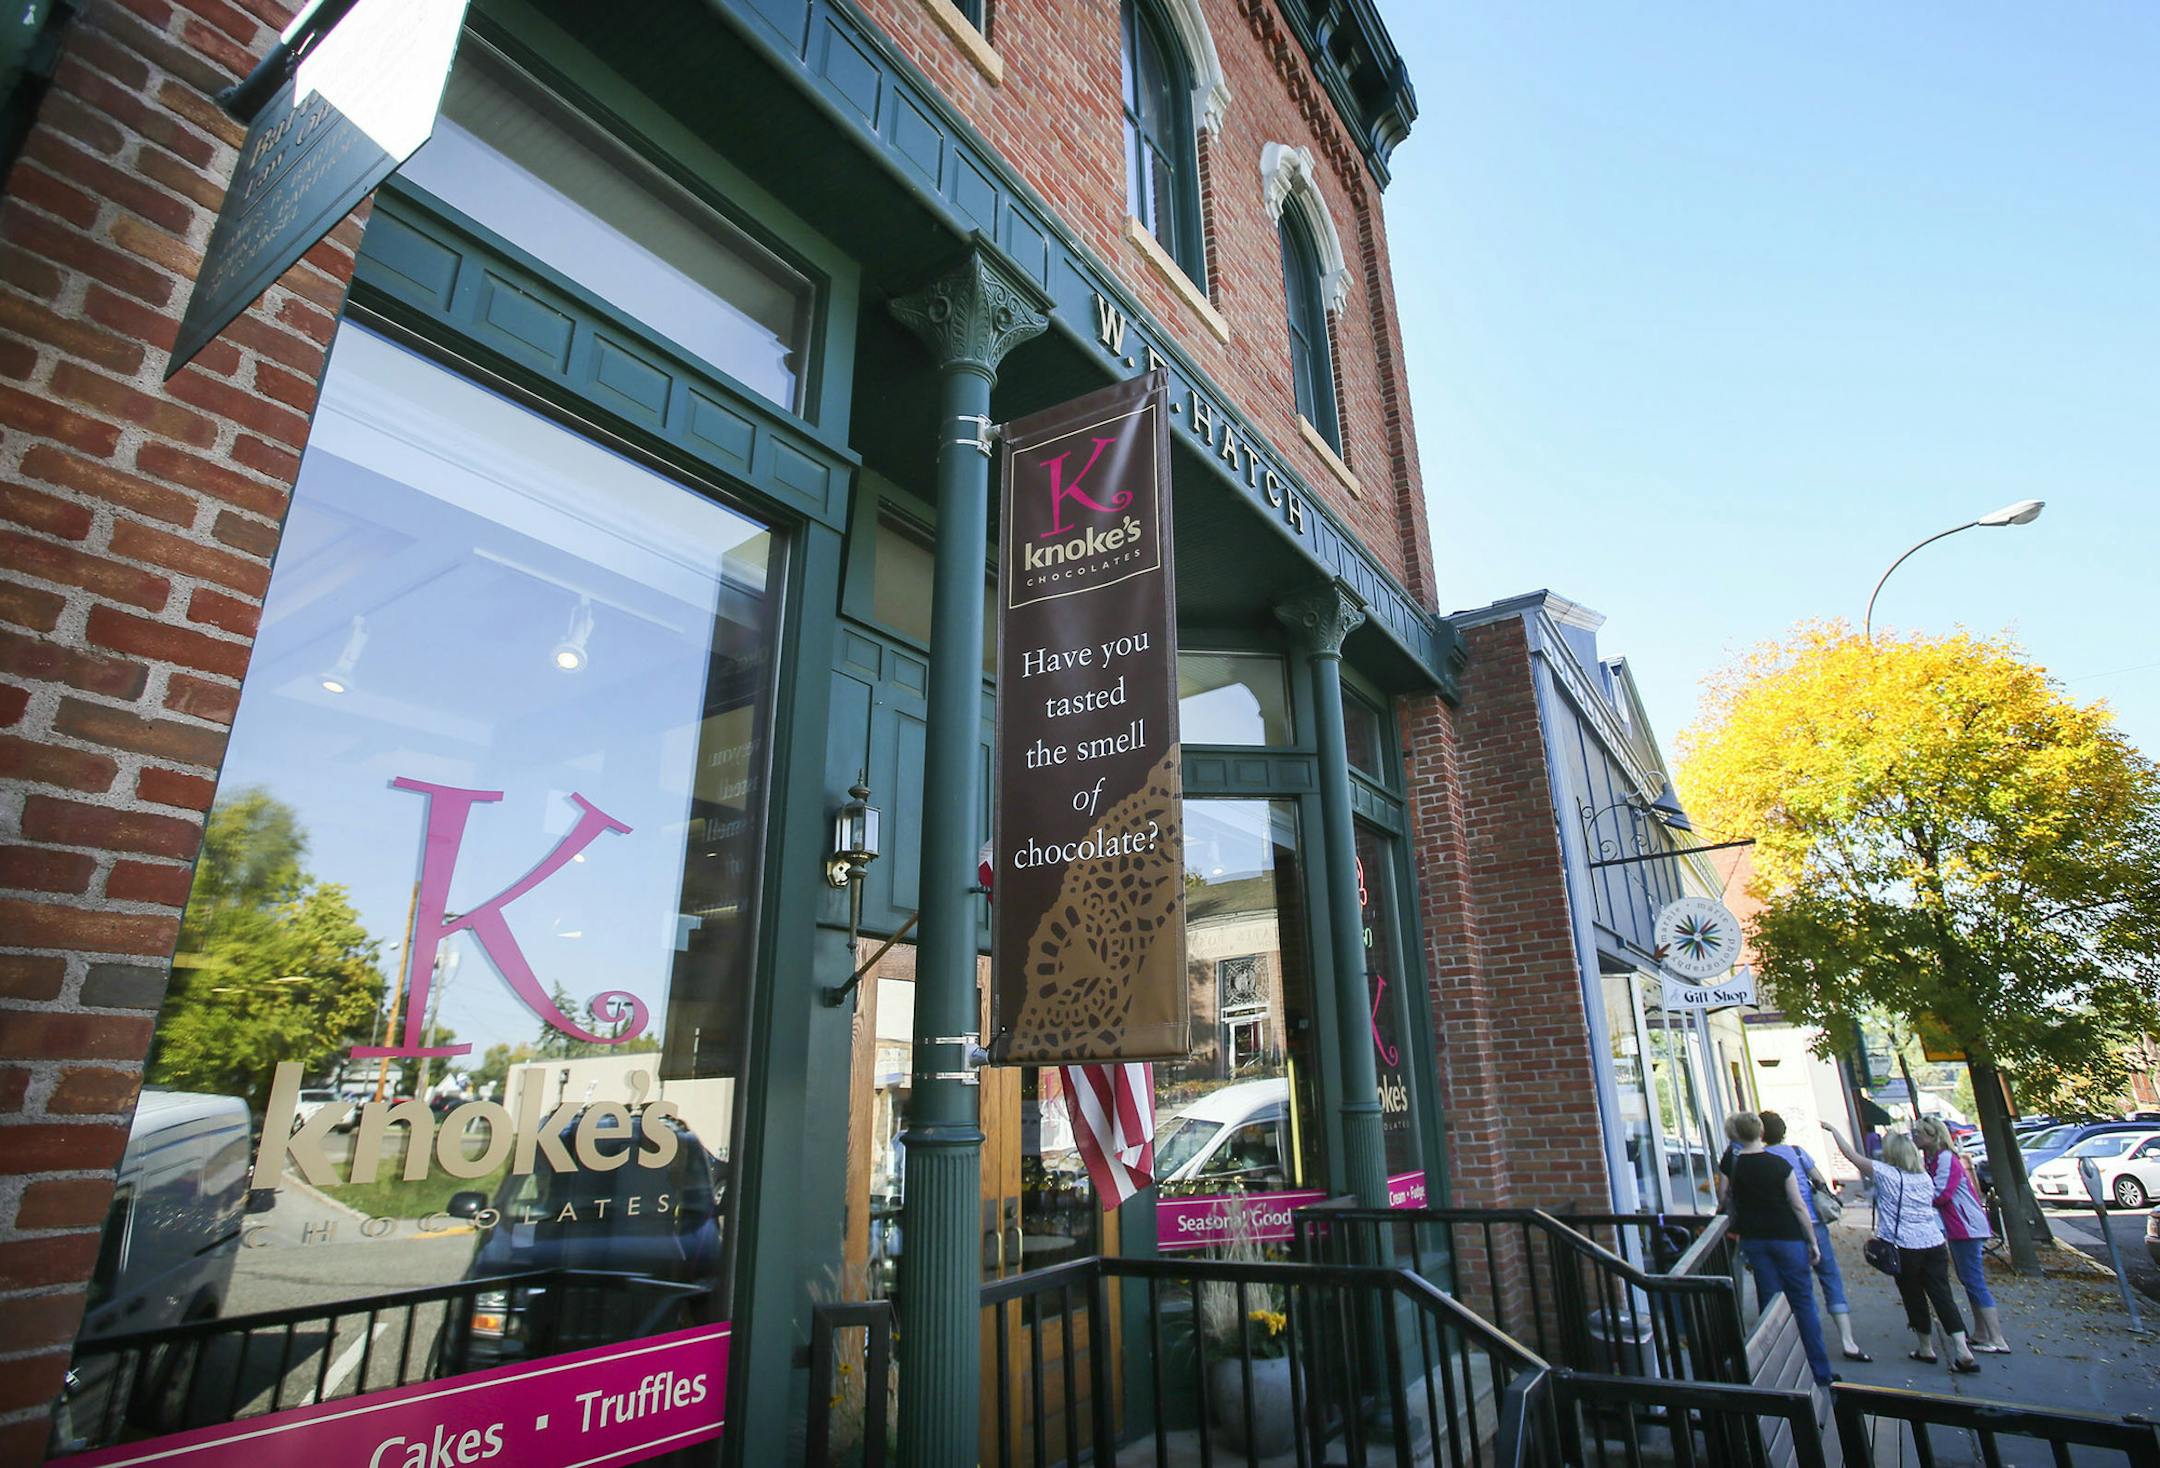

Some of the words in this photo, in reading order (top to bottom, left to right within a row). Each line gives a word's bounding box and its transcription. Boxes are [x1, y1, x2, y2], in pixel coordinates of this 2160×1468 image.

[1092, 292, 1134, 368] W.
[1187, 390, 1304, 534] HATCH
[1040, 437, 1133, 538] K
[1025, 516, 1142, 571] knoke's
[1026, 548, 1141, 587] CHOCOLATES
[1022, 648, 1092, 679] Have
[1101, 632, 1149, 668] you
[1046, 676, 1126, 719] tasted
[1026, 741, 1067, 769] the
[1077, 719, 1146, 762] smell
[1072, 777, 1106, 816] of
[1013, 821, 1159, 869] chocolate?
[351, 776, 650, 1059] K
[1684, 989, 1709, 1003] Gift
[1713, 988, 1748, 1004] Shop
[1377, 1074, 1408, 1113] oke's
[251, 1061, 679, 1190] knoke's
[243, 1193, 672, 1248] CHOCOLATES
[369, 1423, 504, 1468] Cakes
[576, 1371, 707, 1433] Truffles
